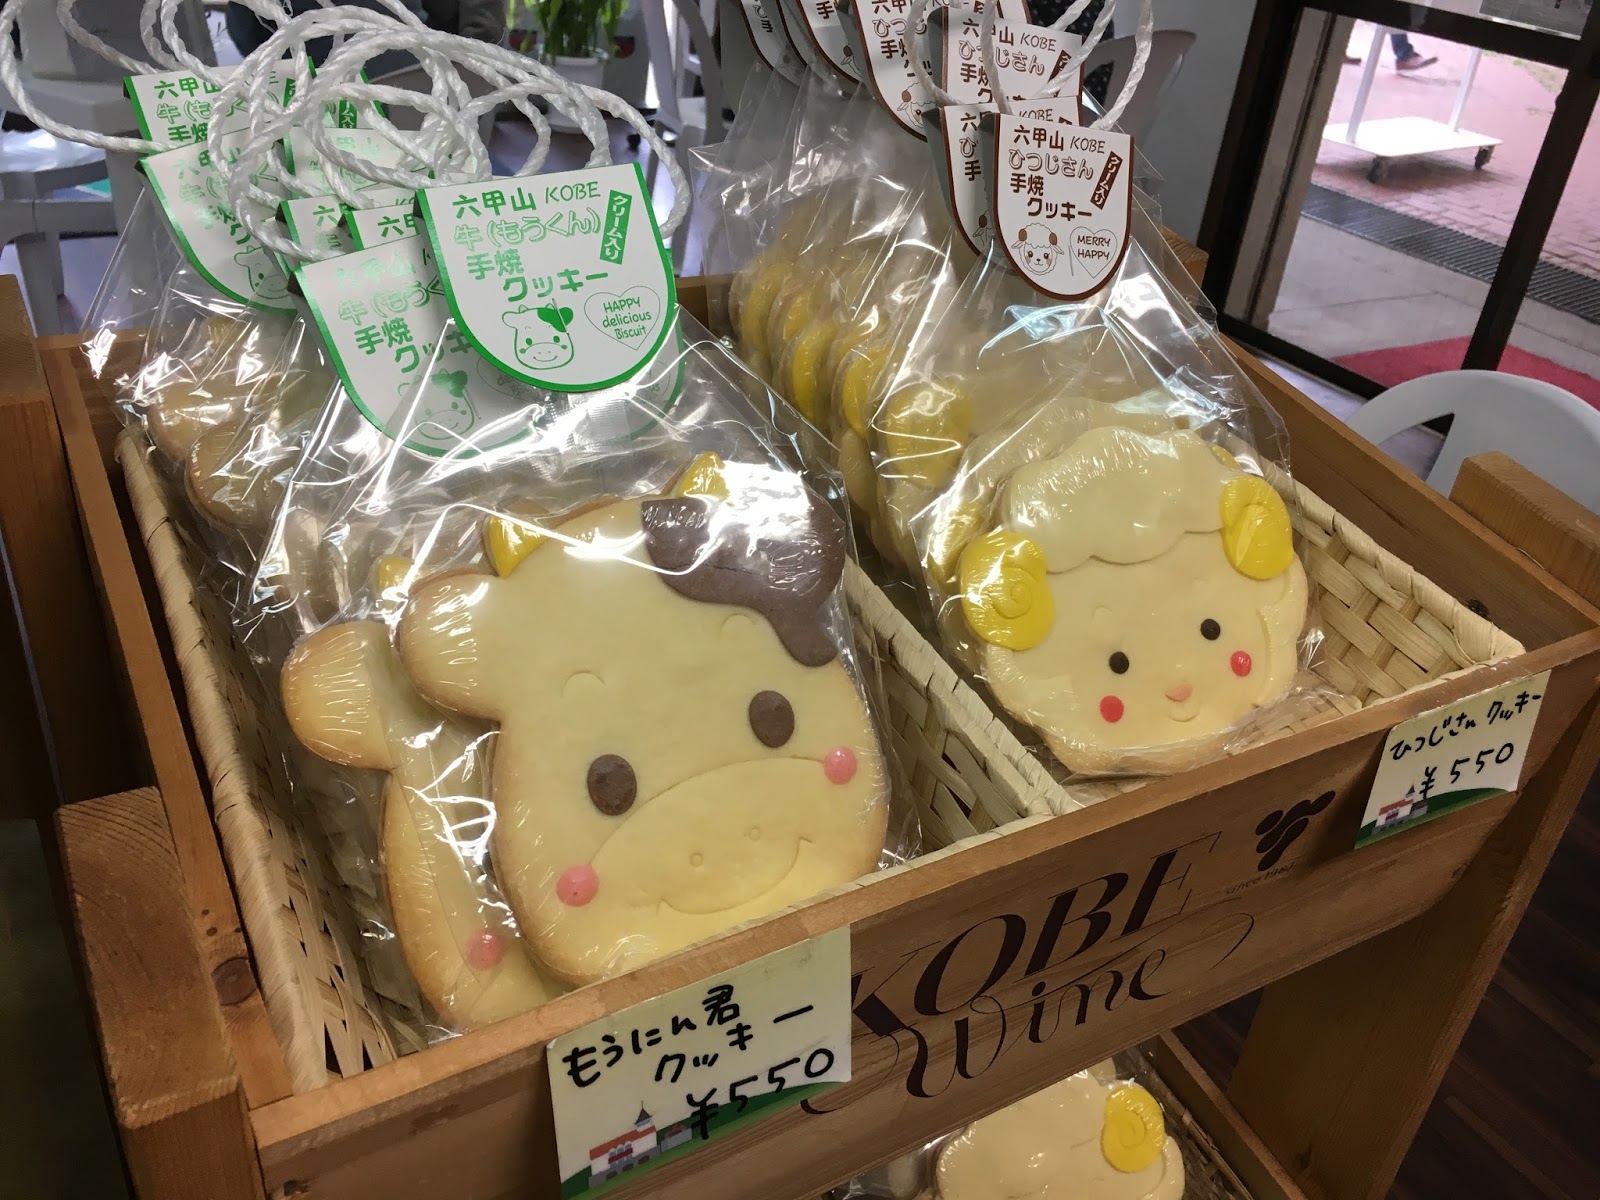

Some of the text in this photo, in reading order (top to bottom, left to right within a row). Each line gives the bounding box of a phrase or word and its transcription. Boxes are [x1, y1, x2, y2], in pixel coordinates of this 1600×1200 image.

[962, 18, 1057, 52] 六山 KOBE
[1019, 108, 1054, 123] KOBE
[1013, 124, 1106, 154] 六甲山 KOBE
[1008, 148, 1095, 180] ひつじさん
[1092, 154, 1122, 207] クリーム入り
[452, 181, 602, 219] 六甲山 KOBE
[1009, 172, 1045, 197] 手焼
[1026, 198, 1093, 222] クッキー
[453, 206, 602, 252] 牛(もうくん)
[602, 194, 630, 262] クリーム入り
[1077, 234, 1112, 248] MERRY
[465, 248, 525, 281] 手焼
[1077, 248, 1111, 260] HAPPY
[502, 268, 609, 303] クッキー
[602, 296, 642, 314] HAPPY
[602, 309, 652, 328] delicious
[353, 316, 414, 356] 手焼
[614, 325, 647, 341] Biscuit
[394, 329, 472, 374] クッキ
[1389, 690, 1542, 761] ひつじさん クッキー
[1418, 742, 1515, 800] ¥550
[849, 831, 1223, 1042] KOBE
[654, 1004, 815, 1083] クッキー
[685, 1047, 835, 1141] ¥550
